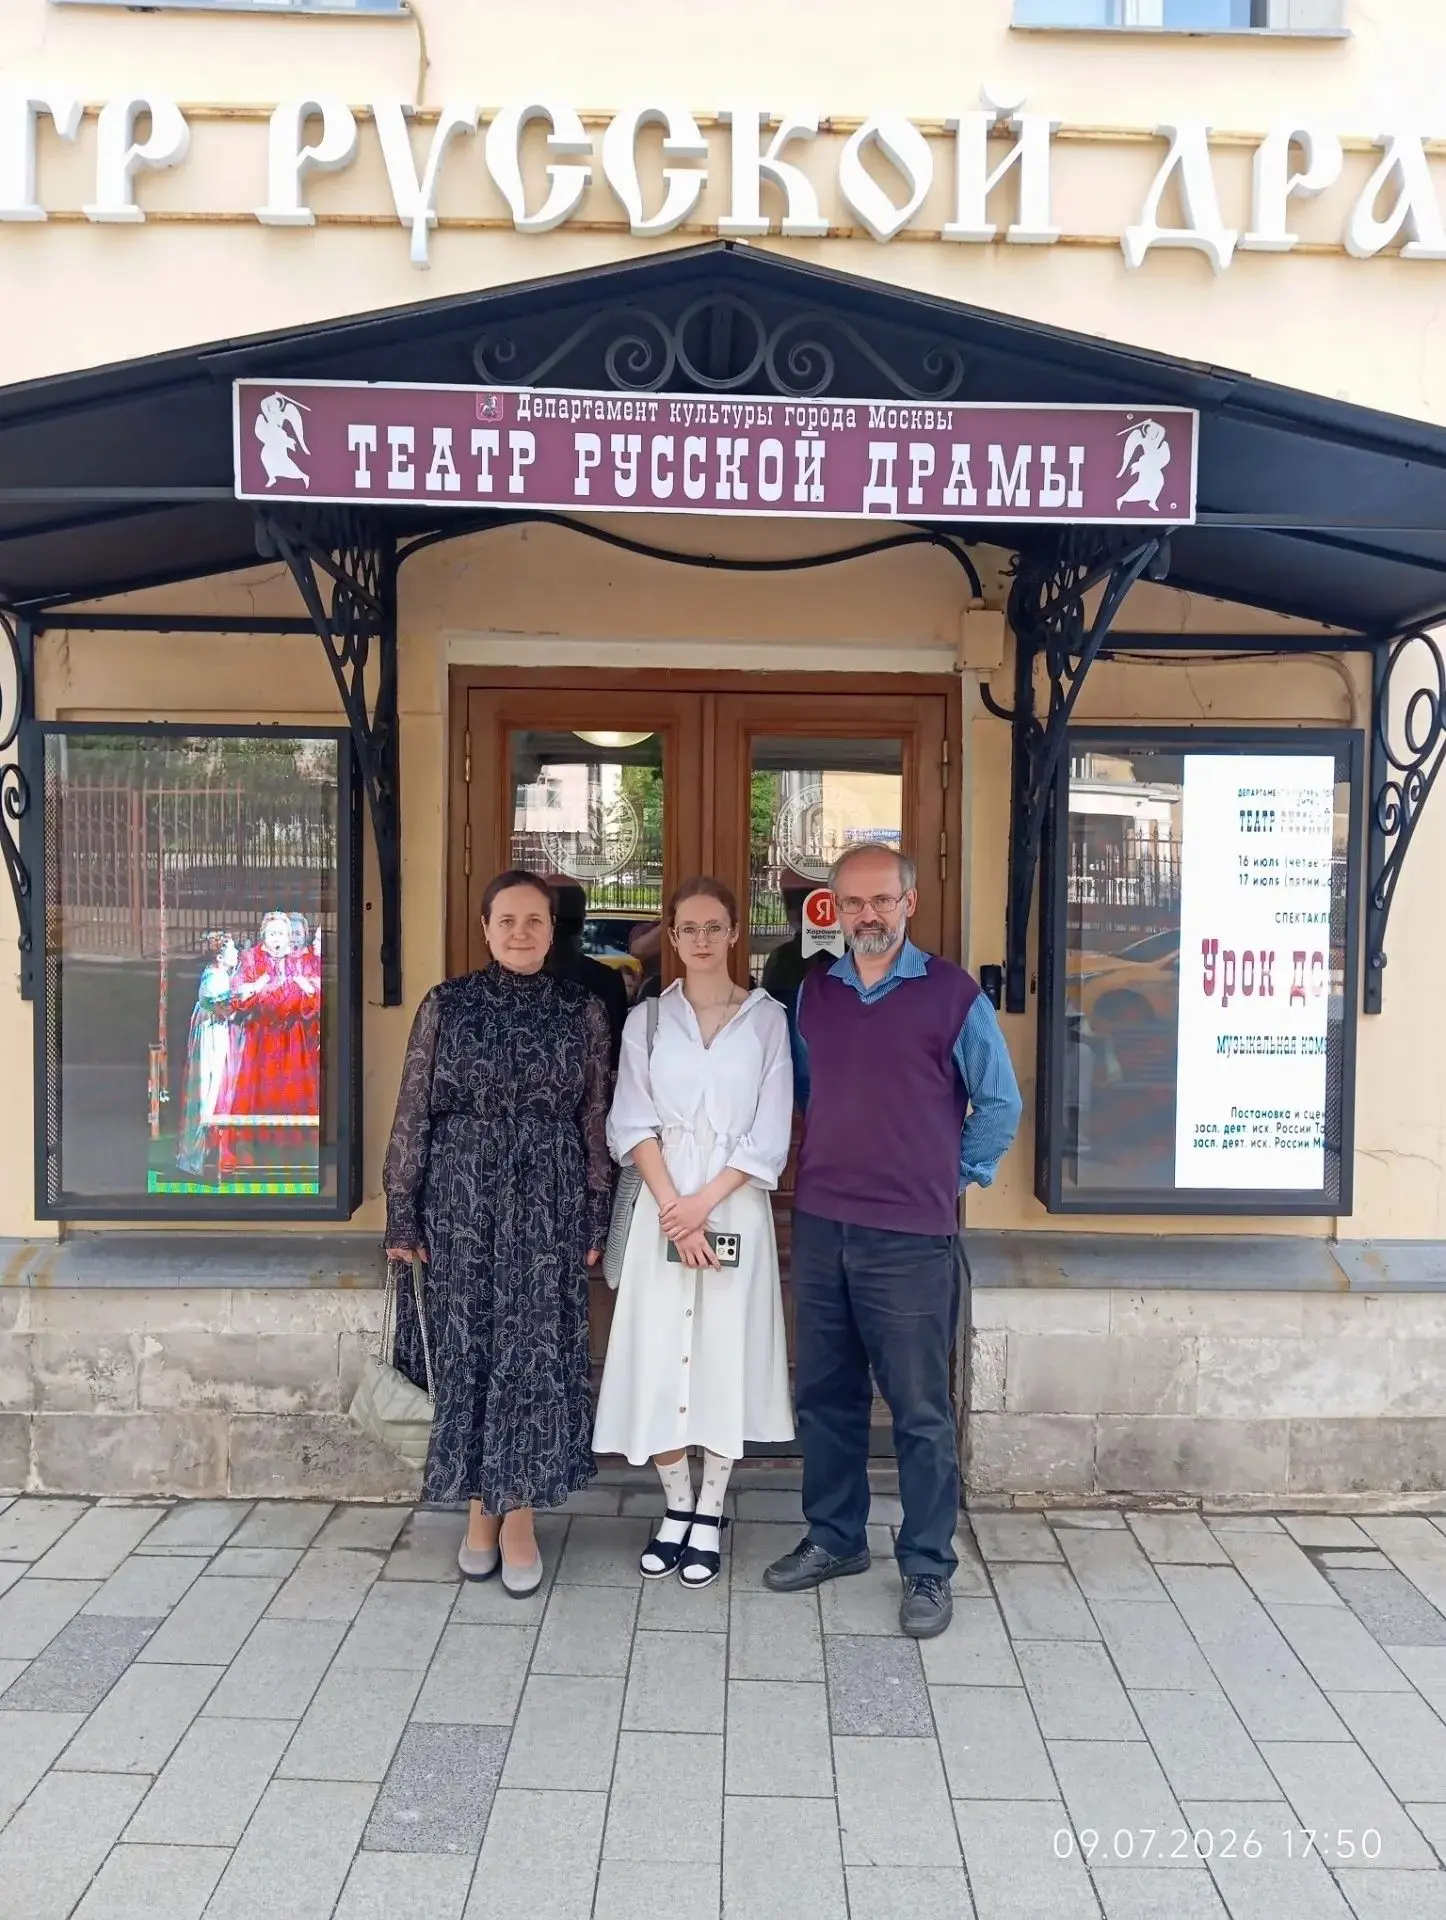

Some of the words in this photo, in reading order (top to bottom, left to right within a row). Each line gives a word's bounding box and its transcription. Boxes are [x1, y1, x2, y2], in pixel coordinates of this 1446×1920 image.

[254, 80, 1062, 270] РУССКОЙ
[1119, 110, 1446, 276] ДРА
[516, 393, 659, 424] Департамент
[669, 401, 773, 429] культуры
[784, 406, 857, 431] города
[868, 405, 953, 430] Москвы
[347, 423, 536, 494] ТЕАТР
[573, 430, 826, 503] РУССКОЙ
[862, 440, 1085, 514] ДРАМЫ
[1240, 809, 1275, 832] ТЕАТР
[1239, 854, 1249, 867] 16
[1253, 857, 1280, 868] июля
[1239, 873, 1249, 885] 17
[1253, 876, 1280, 886] июля
[815, 898, 831, 921] Я
[1201, 938, 1275, 1008] Урок
[1230, 1106, 1291, 1119] Постановка
[1294, 1111, 1300, 1119] и
[1195, 1123, 1220, 1134] засл.
[1276, 1121, 1311, 1134] России
[1193, 1138, 1218, 1149] засл.
[1274, 1136, 1309, 1149] России
